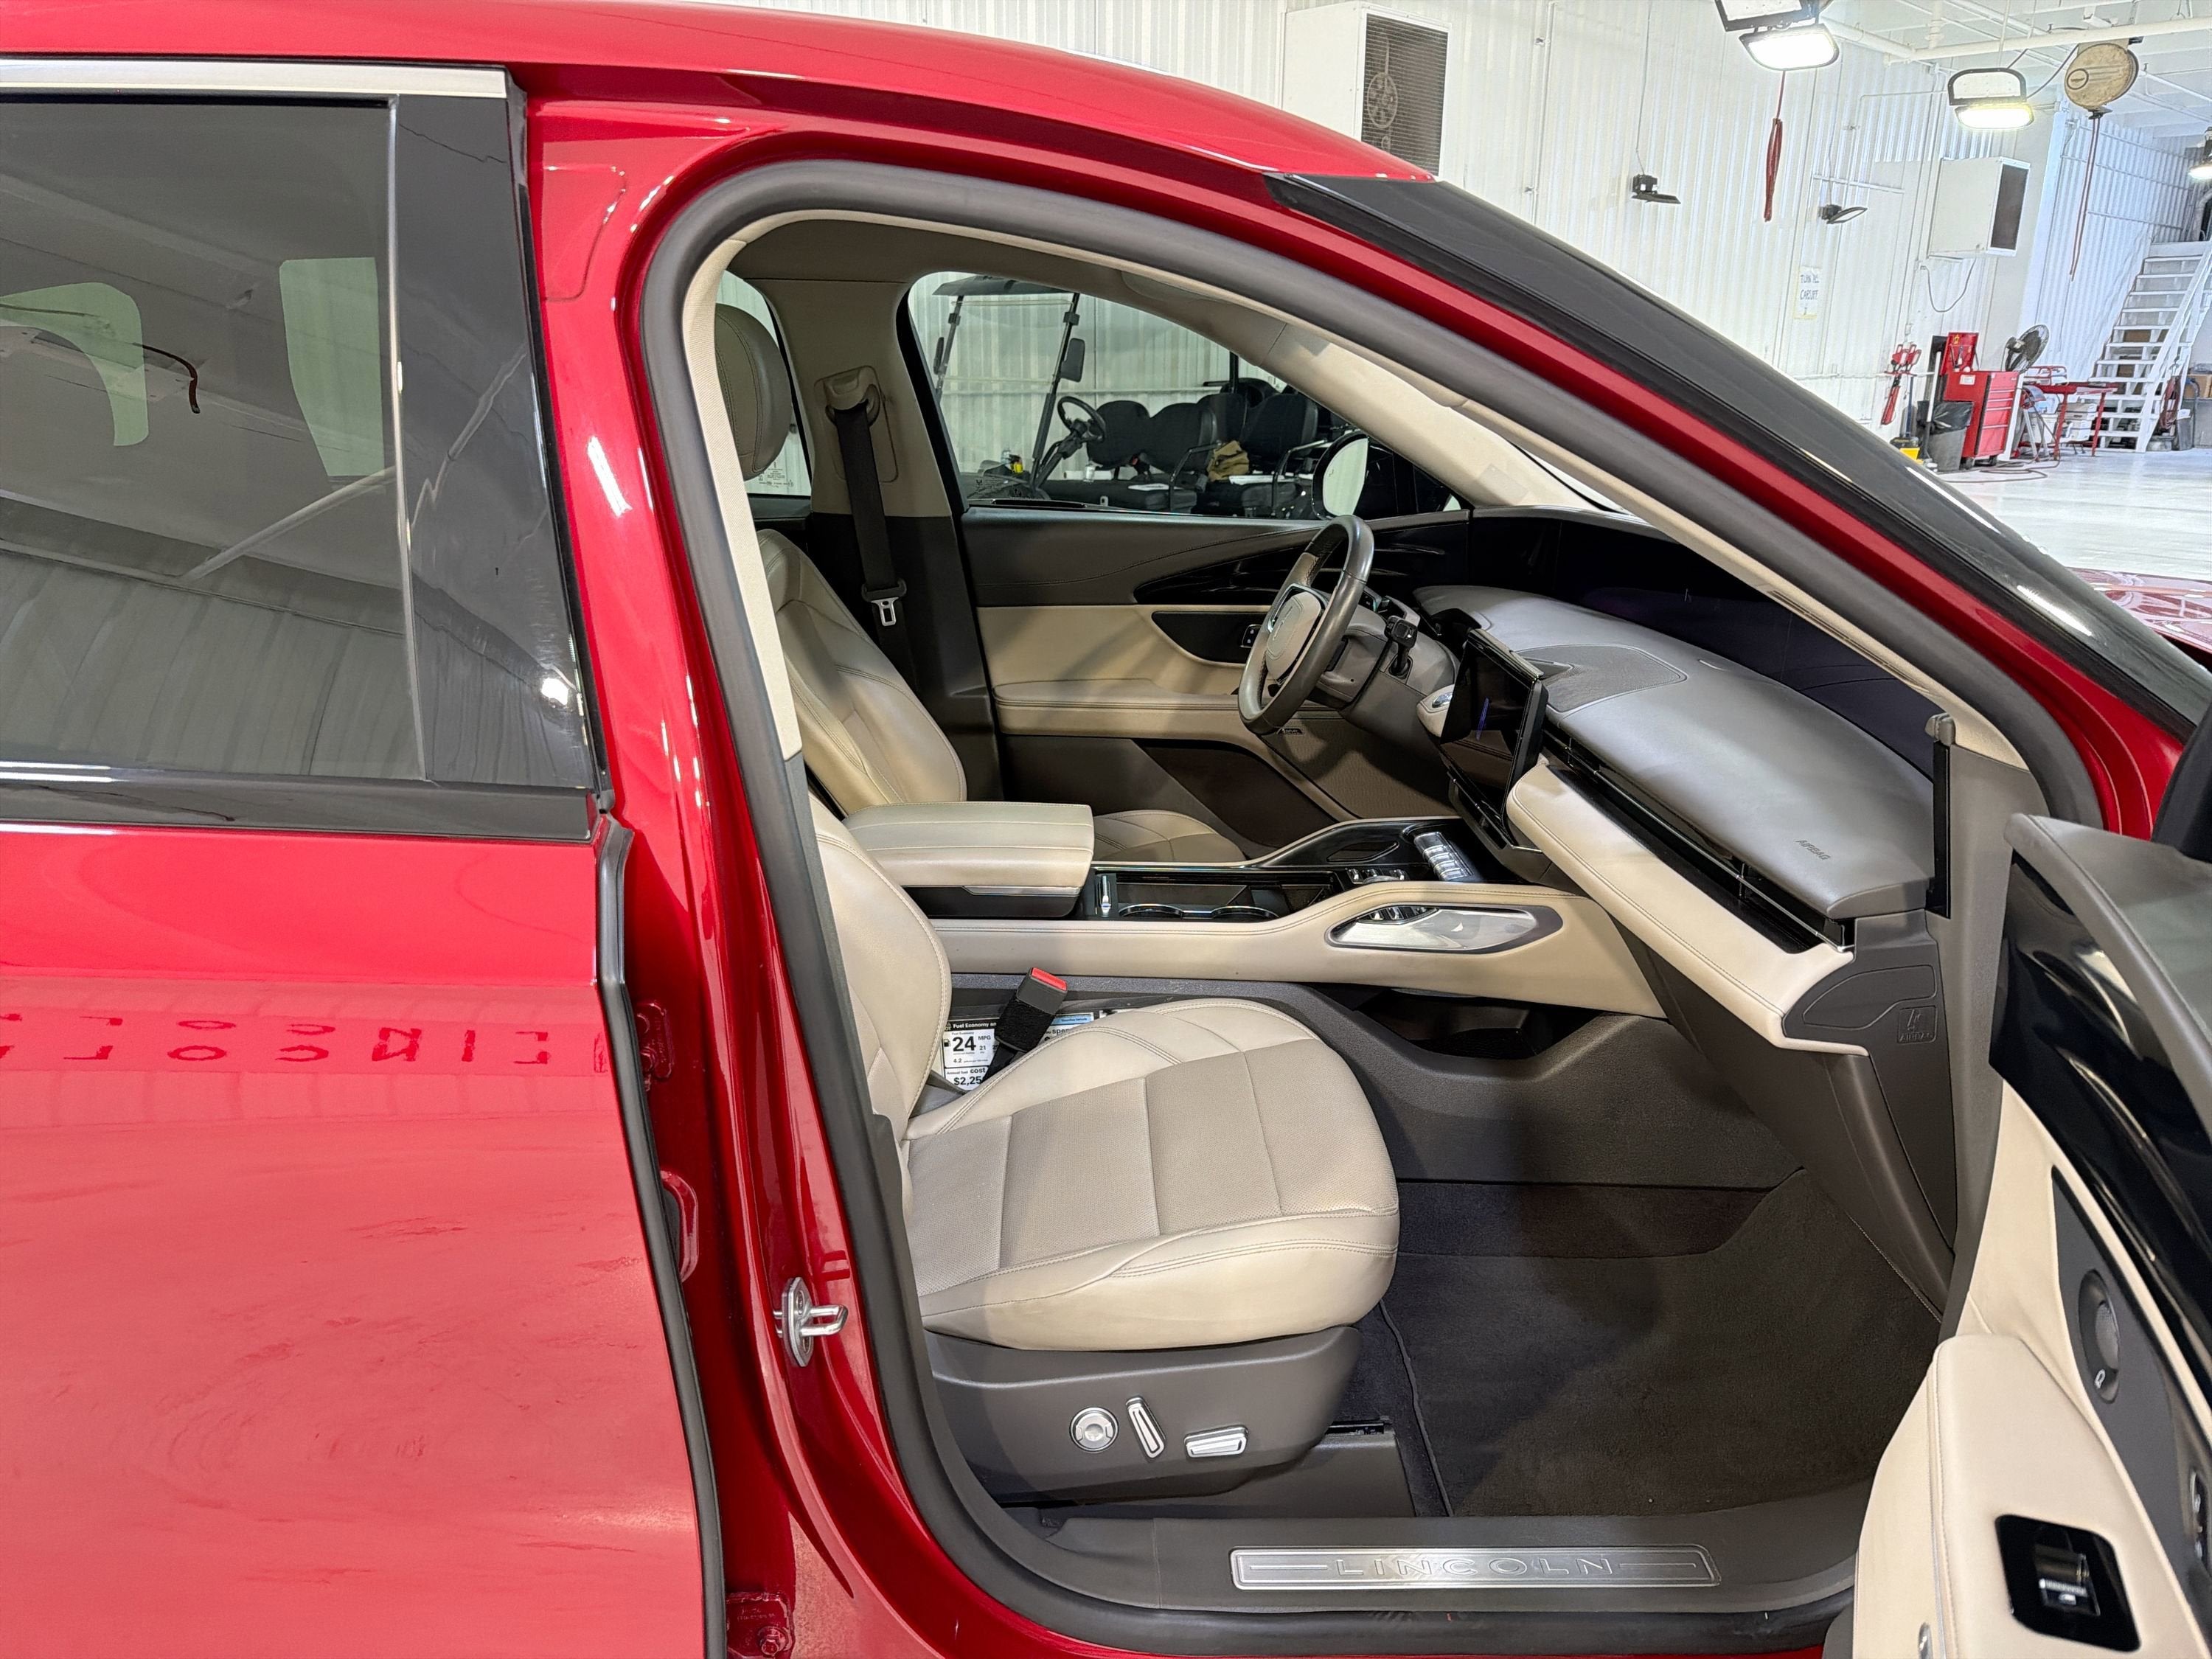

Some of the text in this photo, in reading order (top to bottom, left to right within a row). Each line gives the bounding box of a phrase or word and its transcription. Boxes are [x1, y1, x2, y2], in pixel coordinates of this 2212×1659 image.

[1795, 840, 1831, 860] AIRBAG
[953, 1035, 976, 1051] 24
[954, 1075, 982, 1086] $2,25
[1337, 1557, 1613, 1576] LINCOLN
